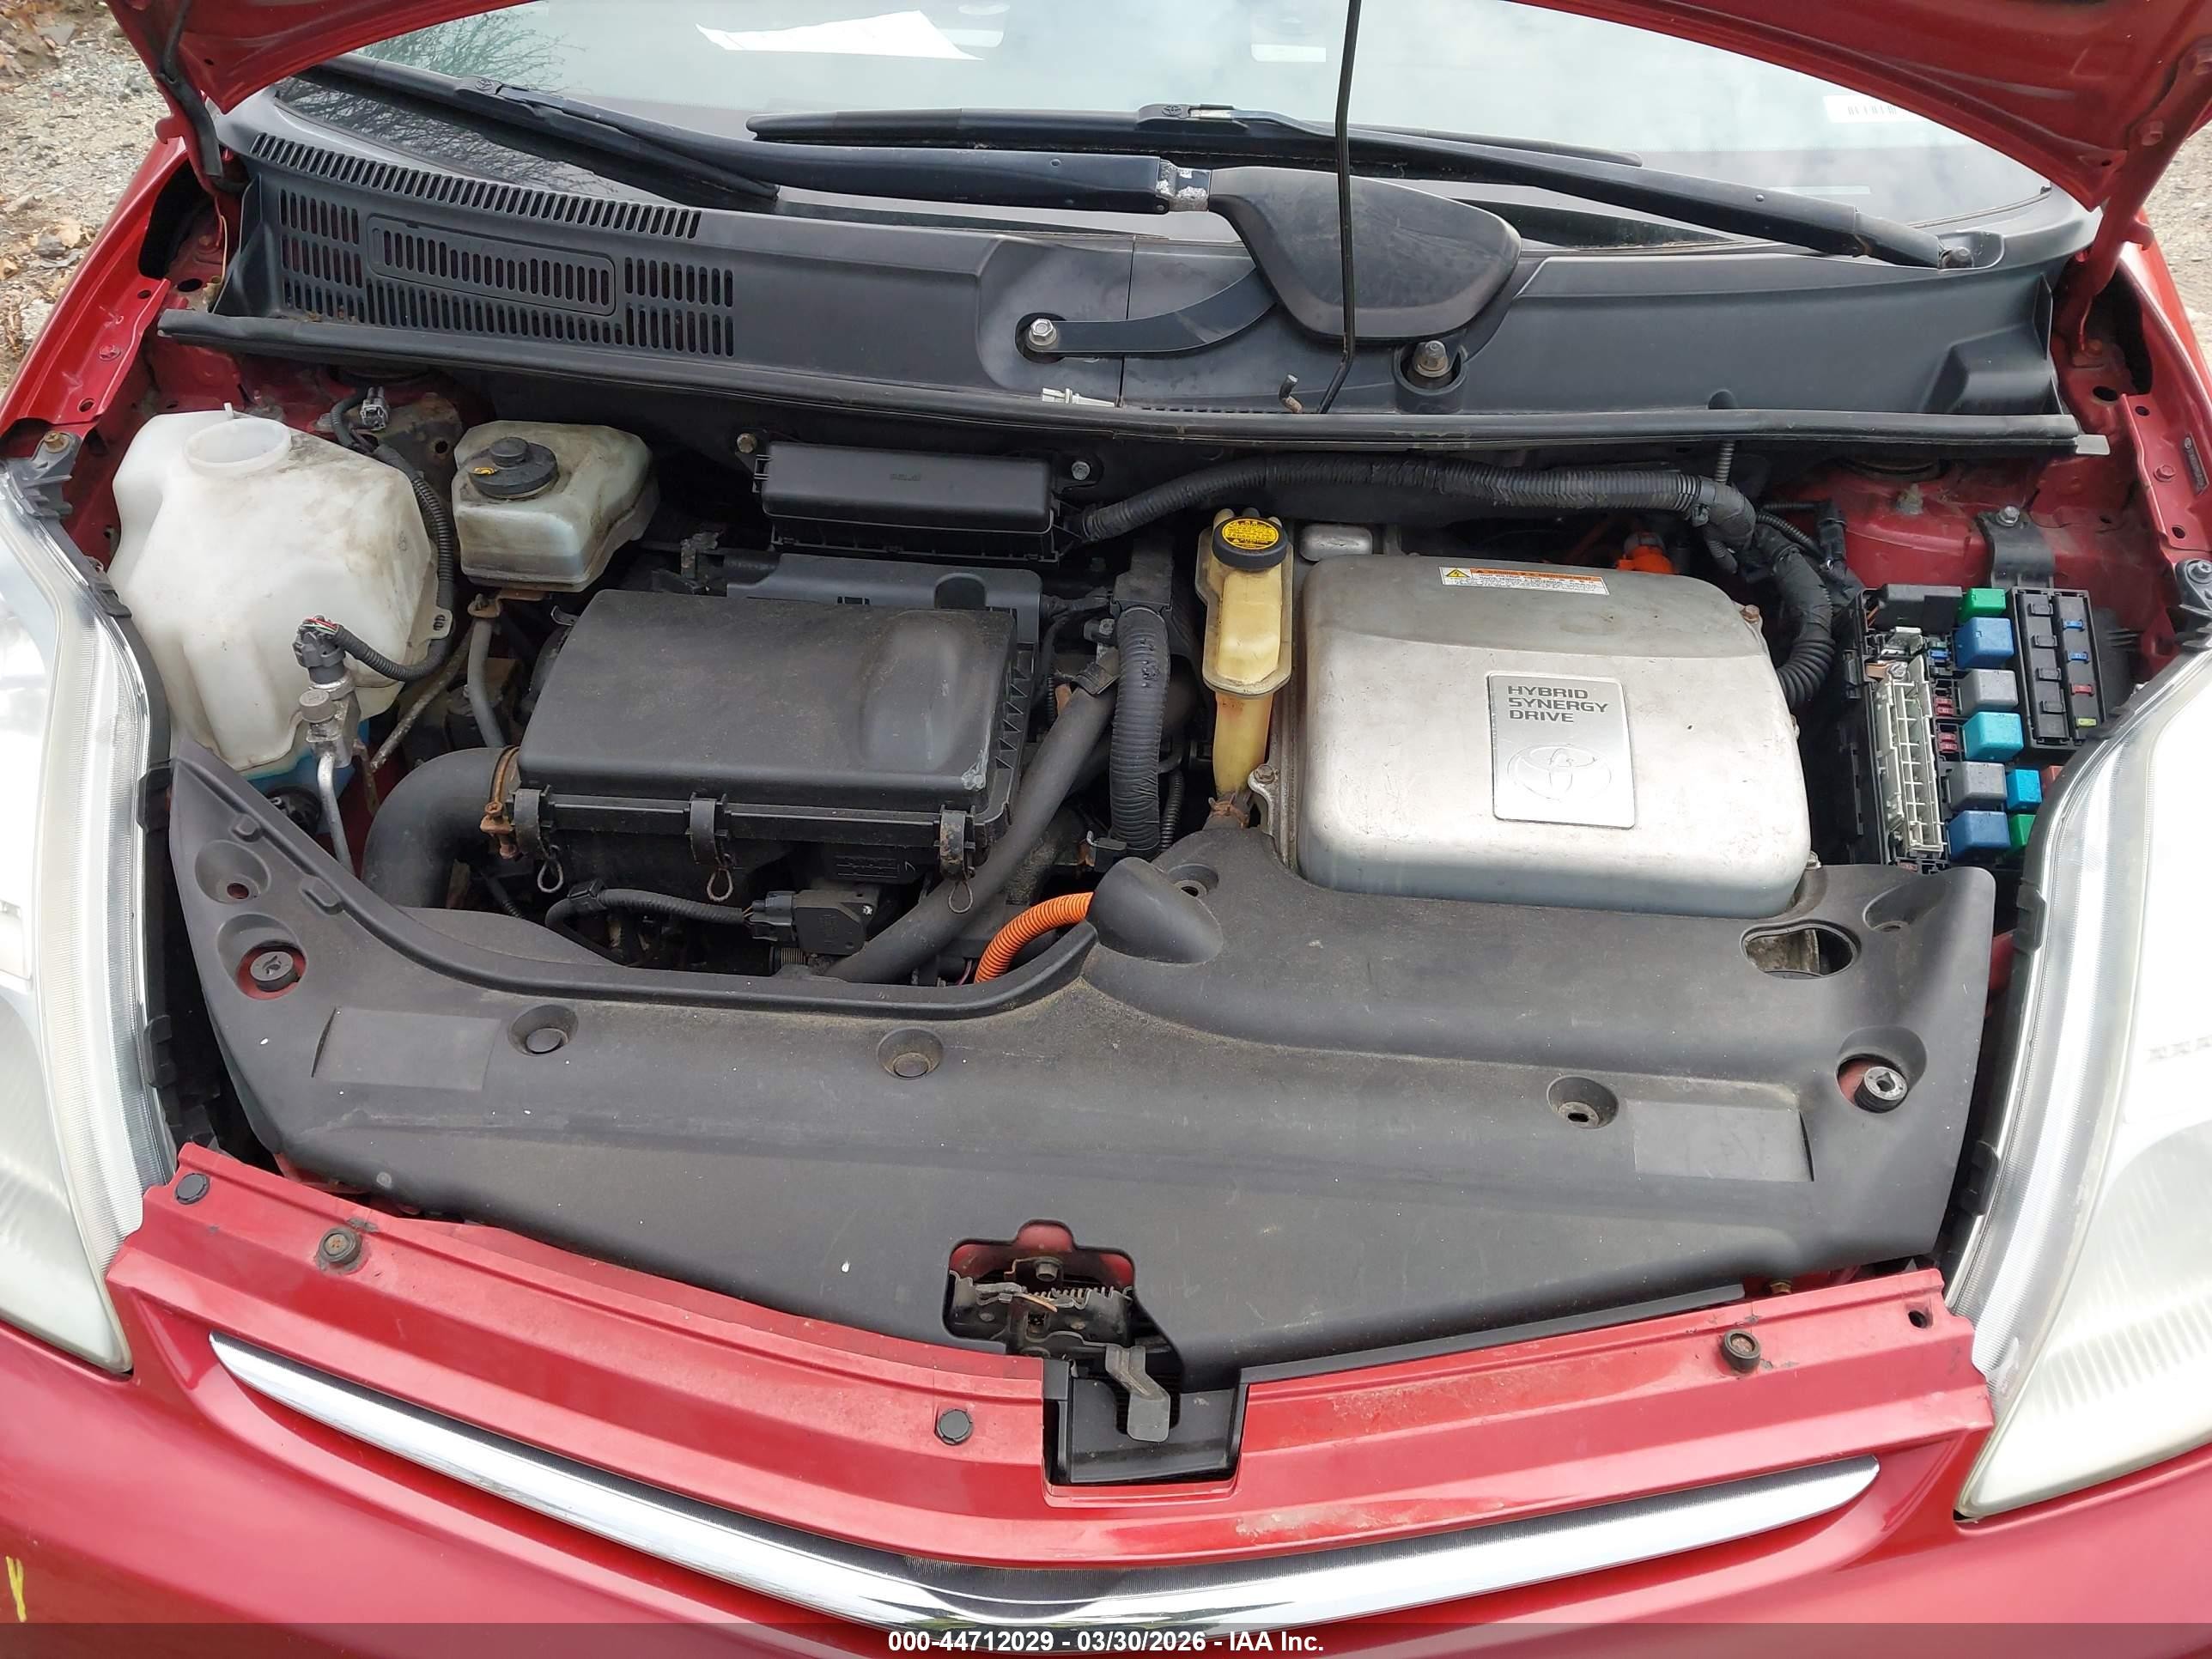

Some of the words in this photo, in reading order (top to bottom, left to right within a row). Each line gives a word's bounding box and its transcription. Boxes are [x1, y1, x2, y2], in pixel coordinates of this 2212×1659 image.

[1508, 685, 1588, 699] HYBRID
[1508, 697, 1608, 713] SYNERGY
[1510, 709, 1574, 723] DRIVE
